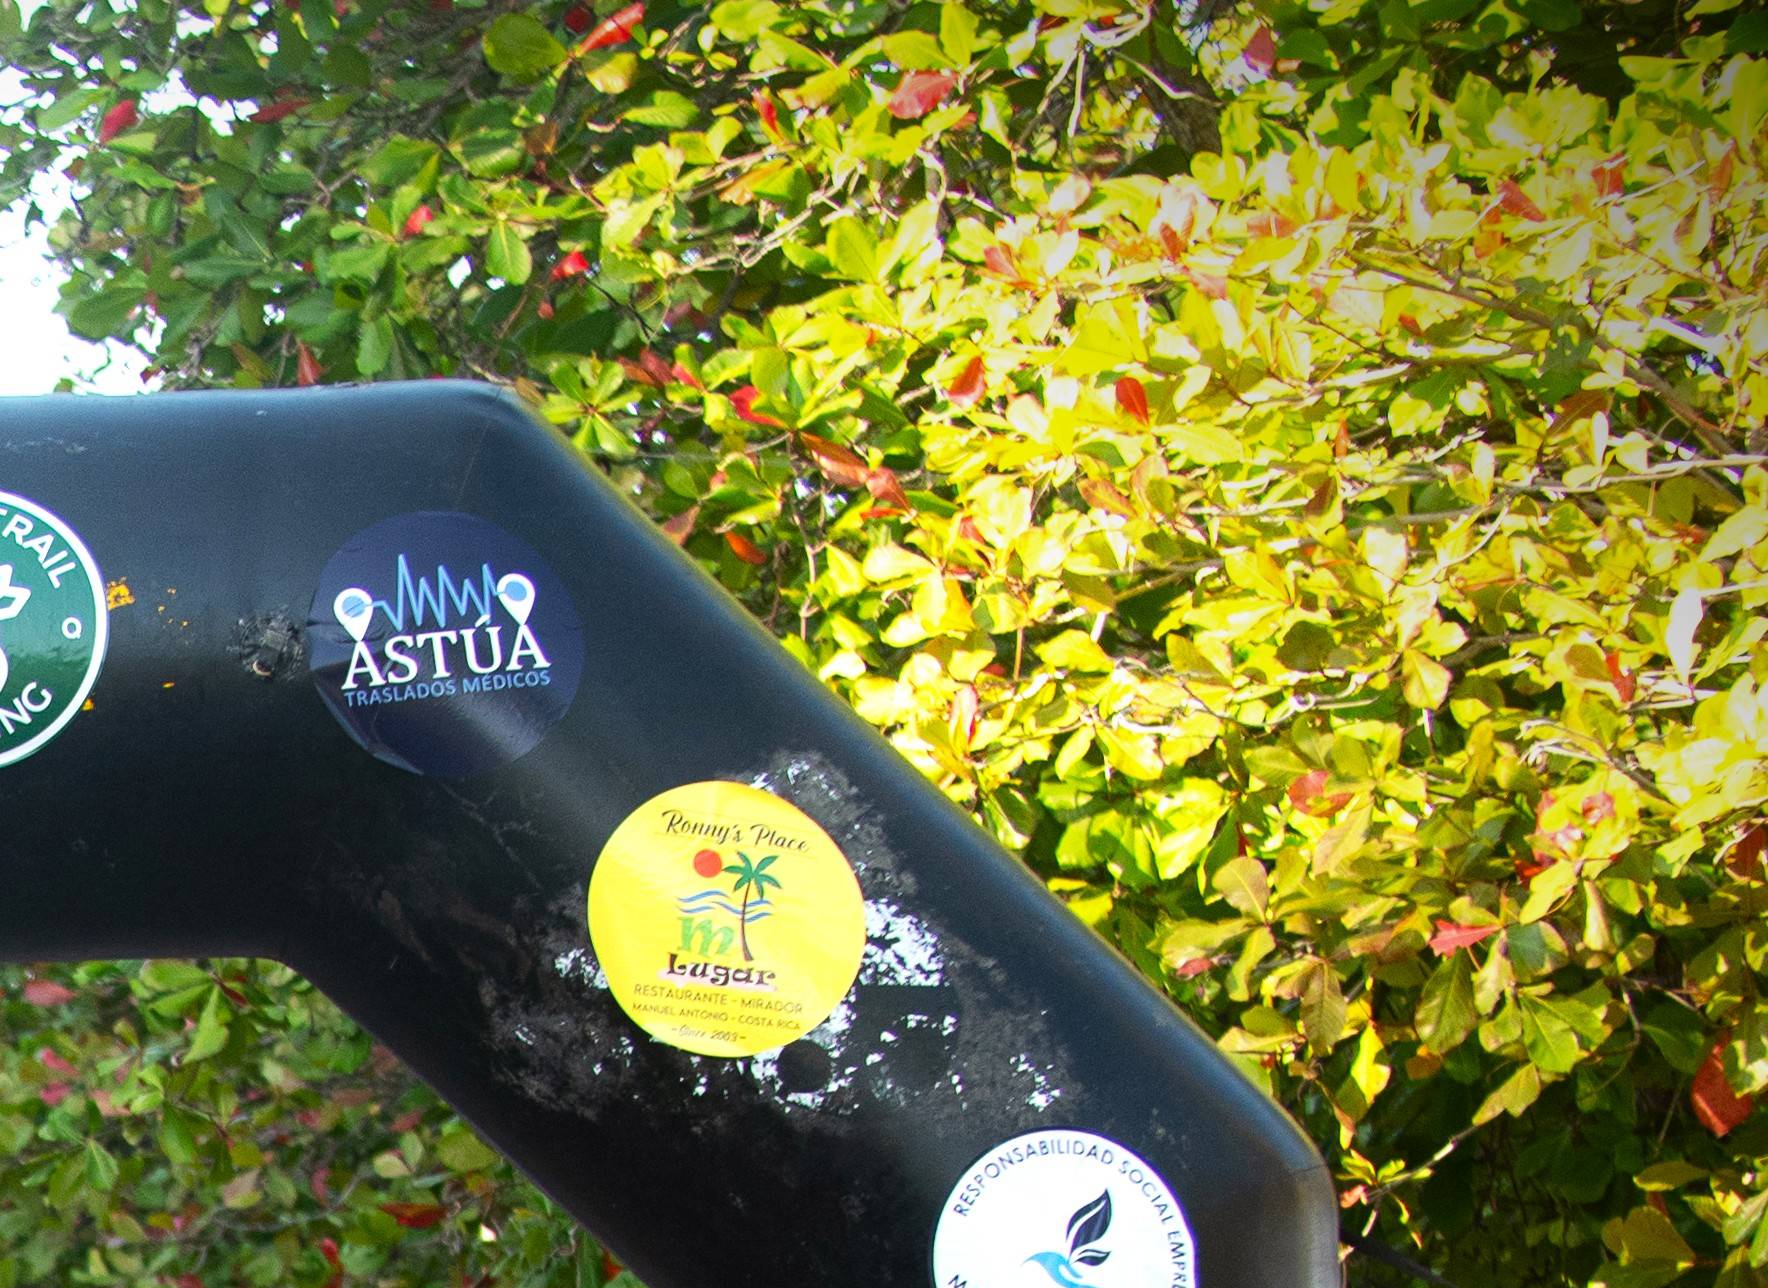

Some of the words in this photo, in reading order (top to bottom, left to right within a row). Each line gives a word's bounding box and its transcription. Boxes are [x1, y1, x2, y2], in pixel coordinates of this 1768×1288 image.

[341, 614, 552, 691] ASTÚA
[343, 678, 457, 707] TRASLADOS
[462, 670, 552, 694] MÉDICOS
[662, 808, 743, 846] Ronny's
[750, 823, 810, 854] Place
[666, 951, 777, 987] Lugar
[633, 983, 729, 1006] RESTAURANTE
[740, 998, 804, 1014] MIRADOR
[739, 1015, 774, 1027] COSTA
[952, 1138, 1115, 1217] RESPONSABILIDAD
[1118, 1160, 1174, 1226] SOCIAL
